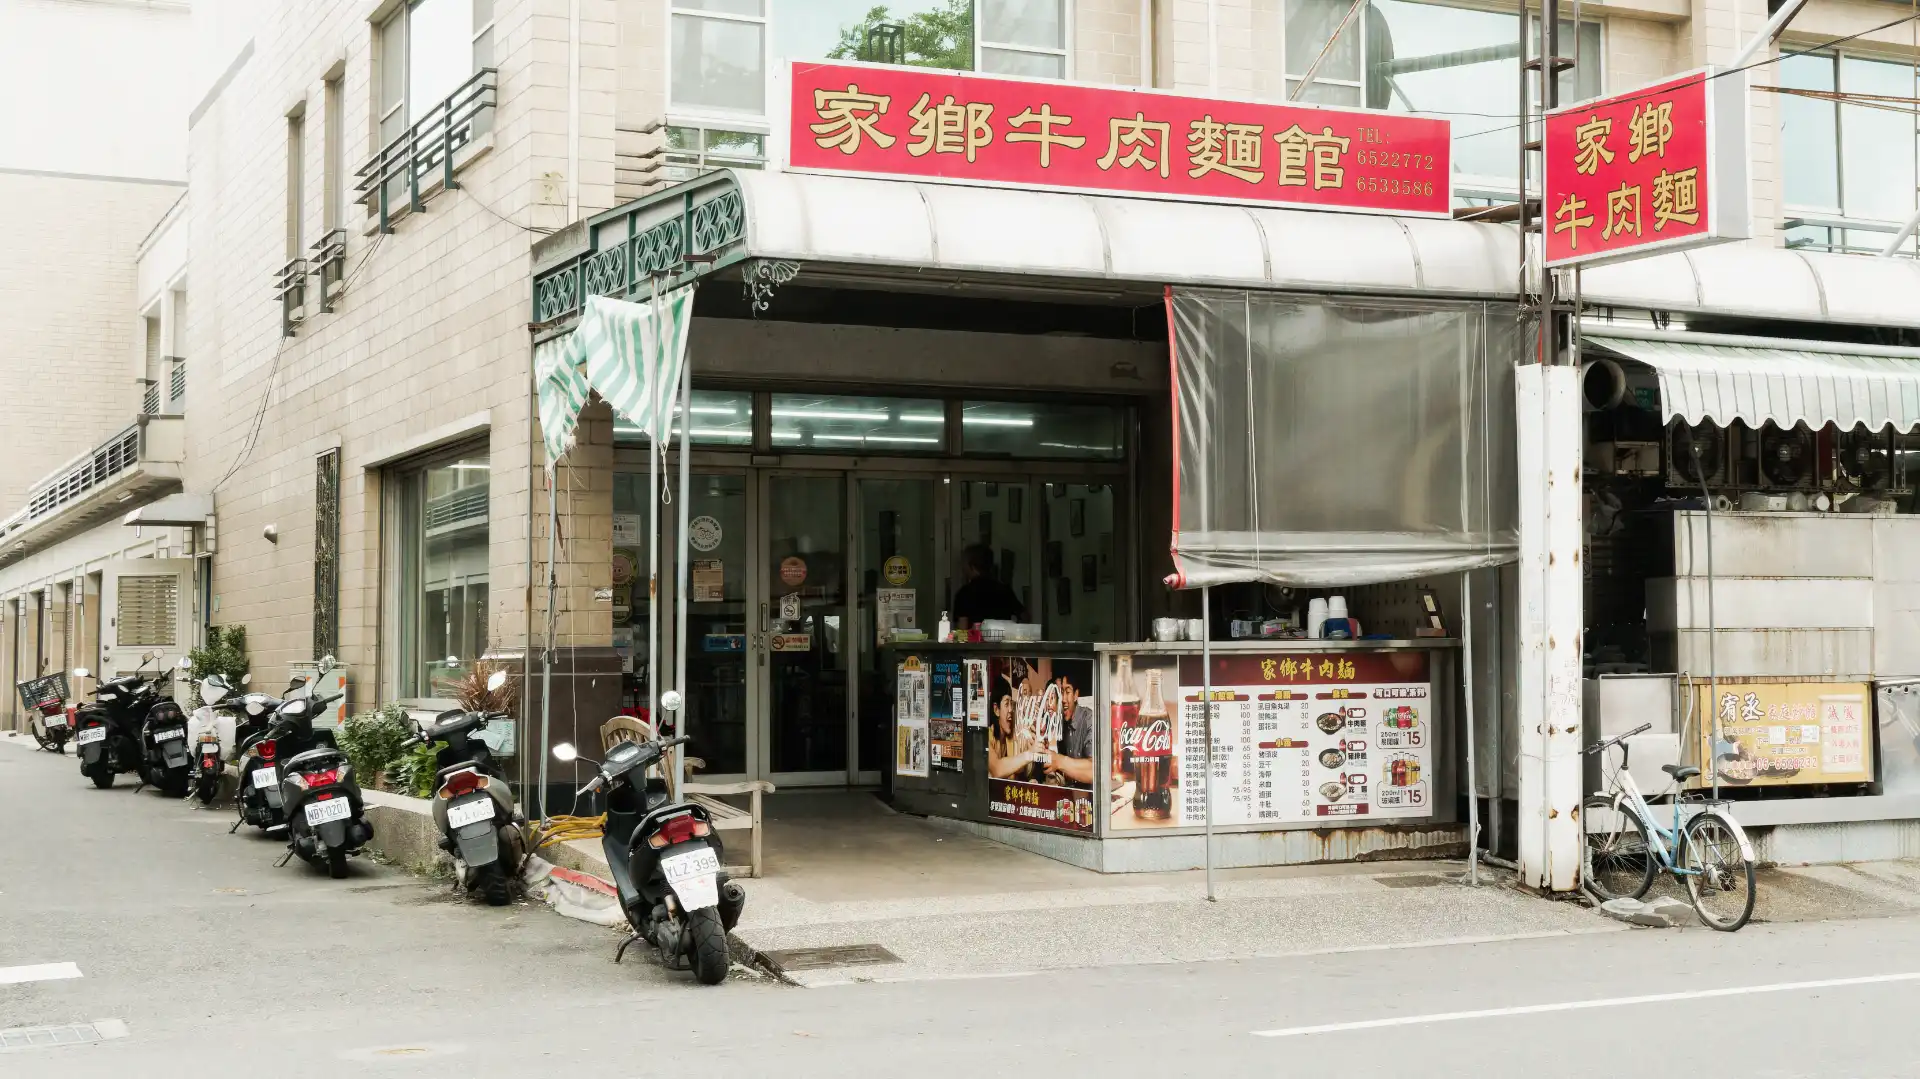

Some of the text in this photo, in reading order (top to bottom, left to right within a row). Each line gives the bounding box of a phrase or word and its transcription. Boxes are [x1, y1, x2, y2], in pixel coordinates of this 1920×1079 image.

[809, 83, 1351, 191] 家鄉牛肉麵館
[1357, 127, 1390, 145] TEL:
[1574, 100, 1674, 176] 家鄉
[1357, 149, 1433, 170] 6522772
[1357, 176, 1433, 196] 6533586
[1554, 166, 1700, 250] 牛肉麵
[1260, 657, 1356, 682] 家鄉牛肉麵
